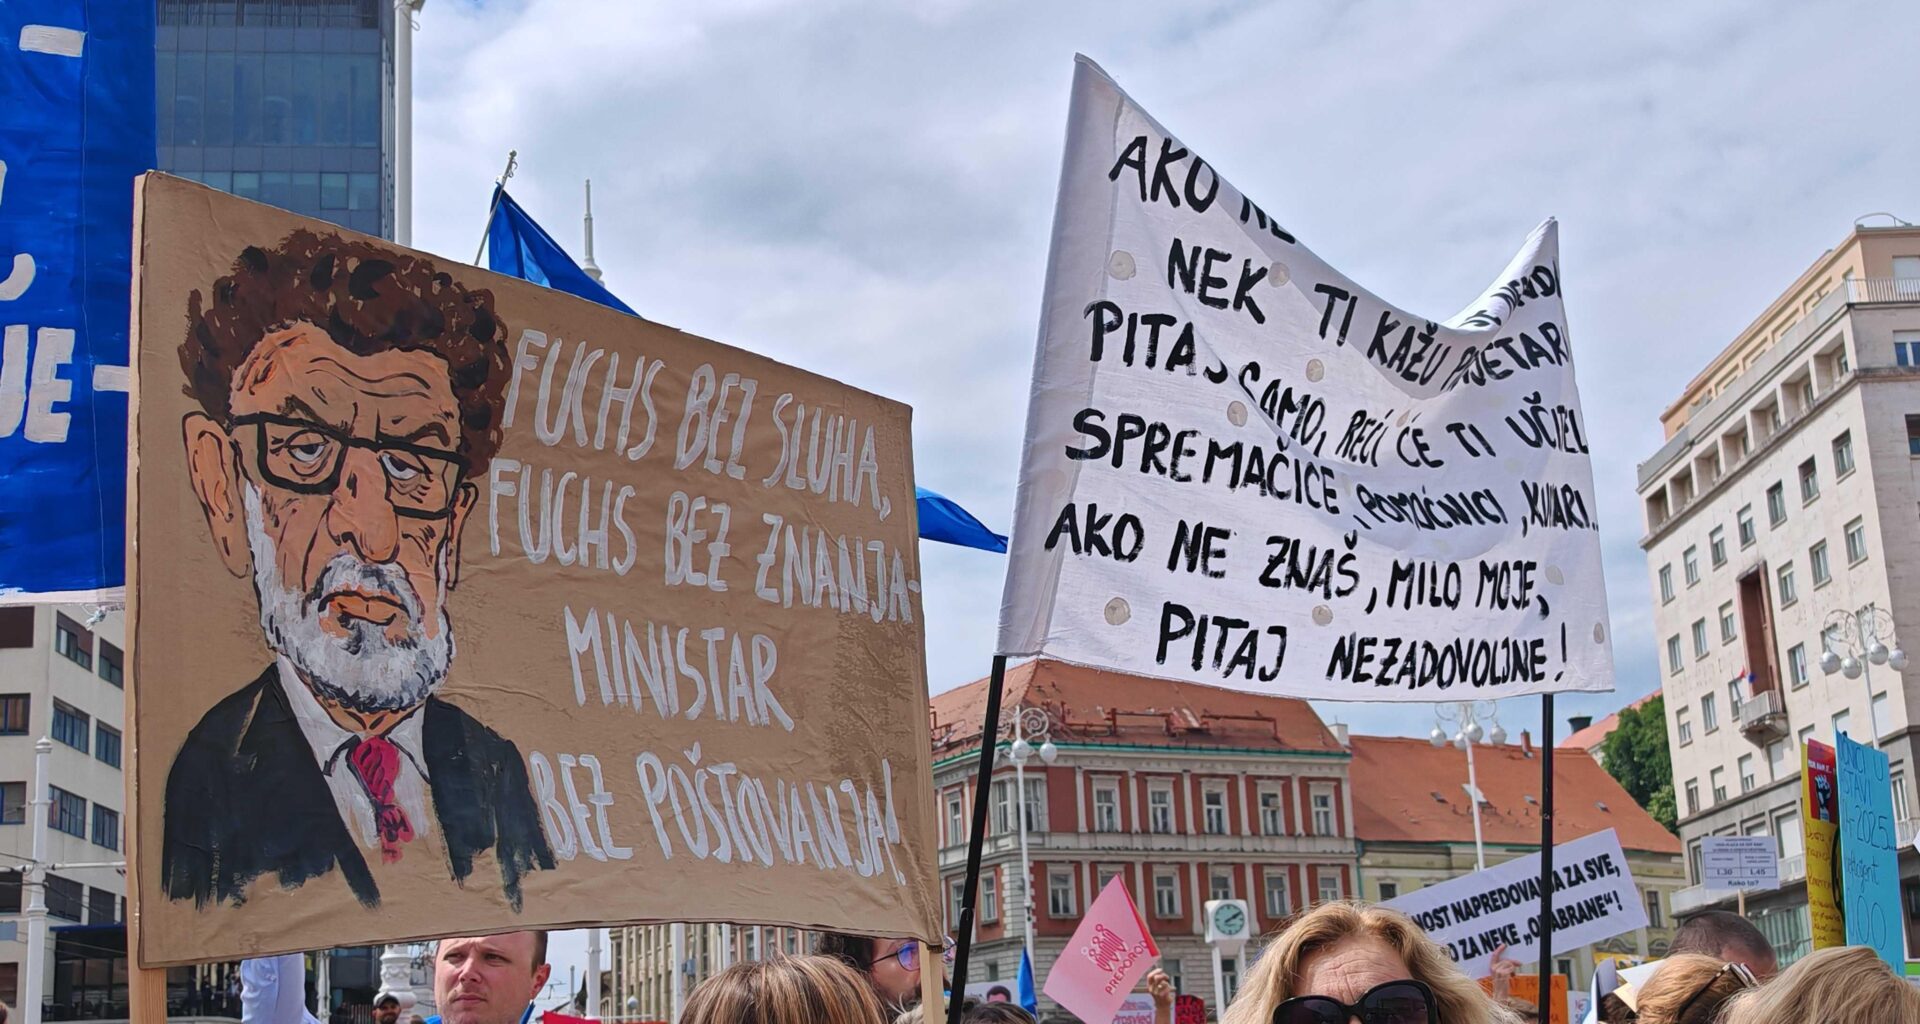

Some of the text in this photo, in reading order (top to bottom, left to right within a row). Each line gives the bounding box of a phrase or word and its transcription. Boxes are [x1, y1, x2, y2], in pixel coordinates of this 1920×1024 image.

[1108, 136, 1220, 213] AKO
[1168, 238, 1268, 324] NEK
[1314, 283, 1358, 346] TI
[1367, 311, 1452, 386] KAŽU
[503, 329, 892, 522] FUCHS BEZ SLUHA,
[1446, 423, 1497, 457] TI
[489, 457, 637, 576] FUCHS
[665, 490, 731, 591] BEZ
[1044, 503, 1145, 563] AKO
[1167, 519, 1232, 579] NE
[1386, 558, 1462, 610] MILO
[1476, 559, 1550, 620] MOJE,
[564, 605, 794, 732] MINISTAR
[1156, 601, 1288, 682] PITAJ
[529, 741, 907, 886] BEZ POŠTOVANJA!
[1562, 863, 1588, 888] ZA
[1583, 853, 1621, 881] SVE,
[1105, 940, 1149, 995] PREPOROD
[1458, 936, 1482, 960] ZA
[1478, 923, 1521, 955] NEKE
